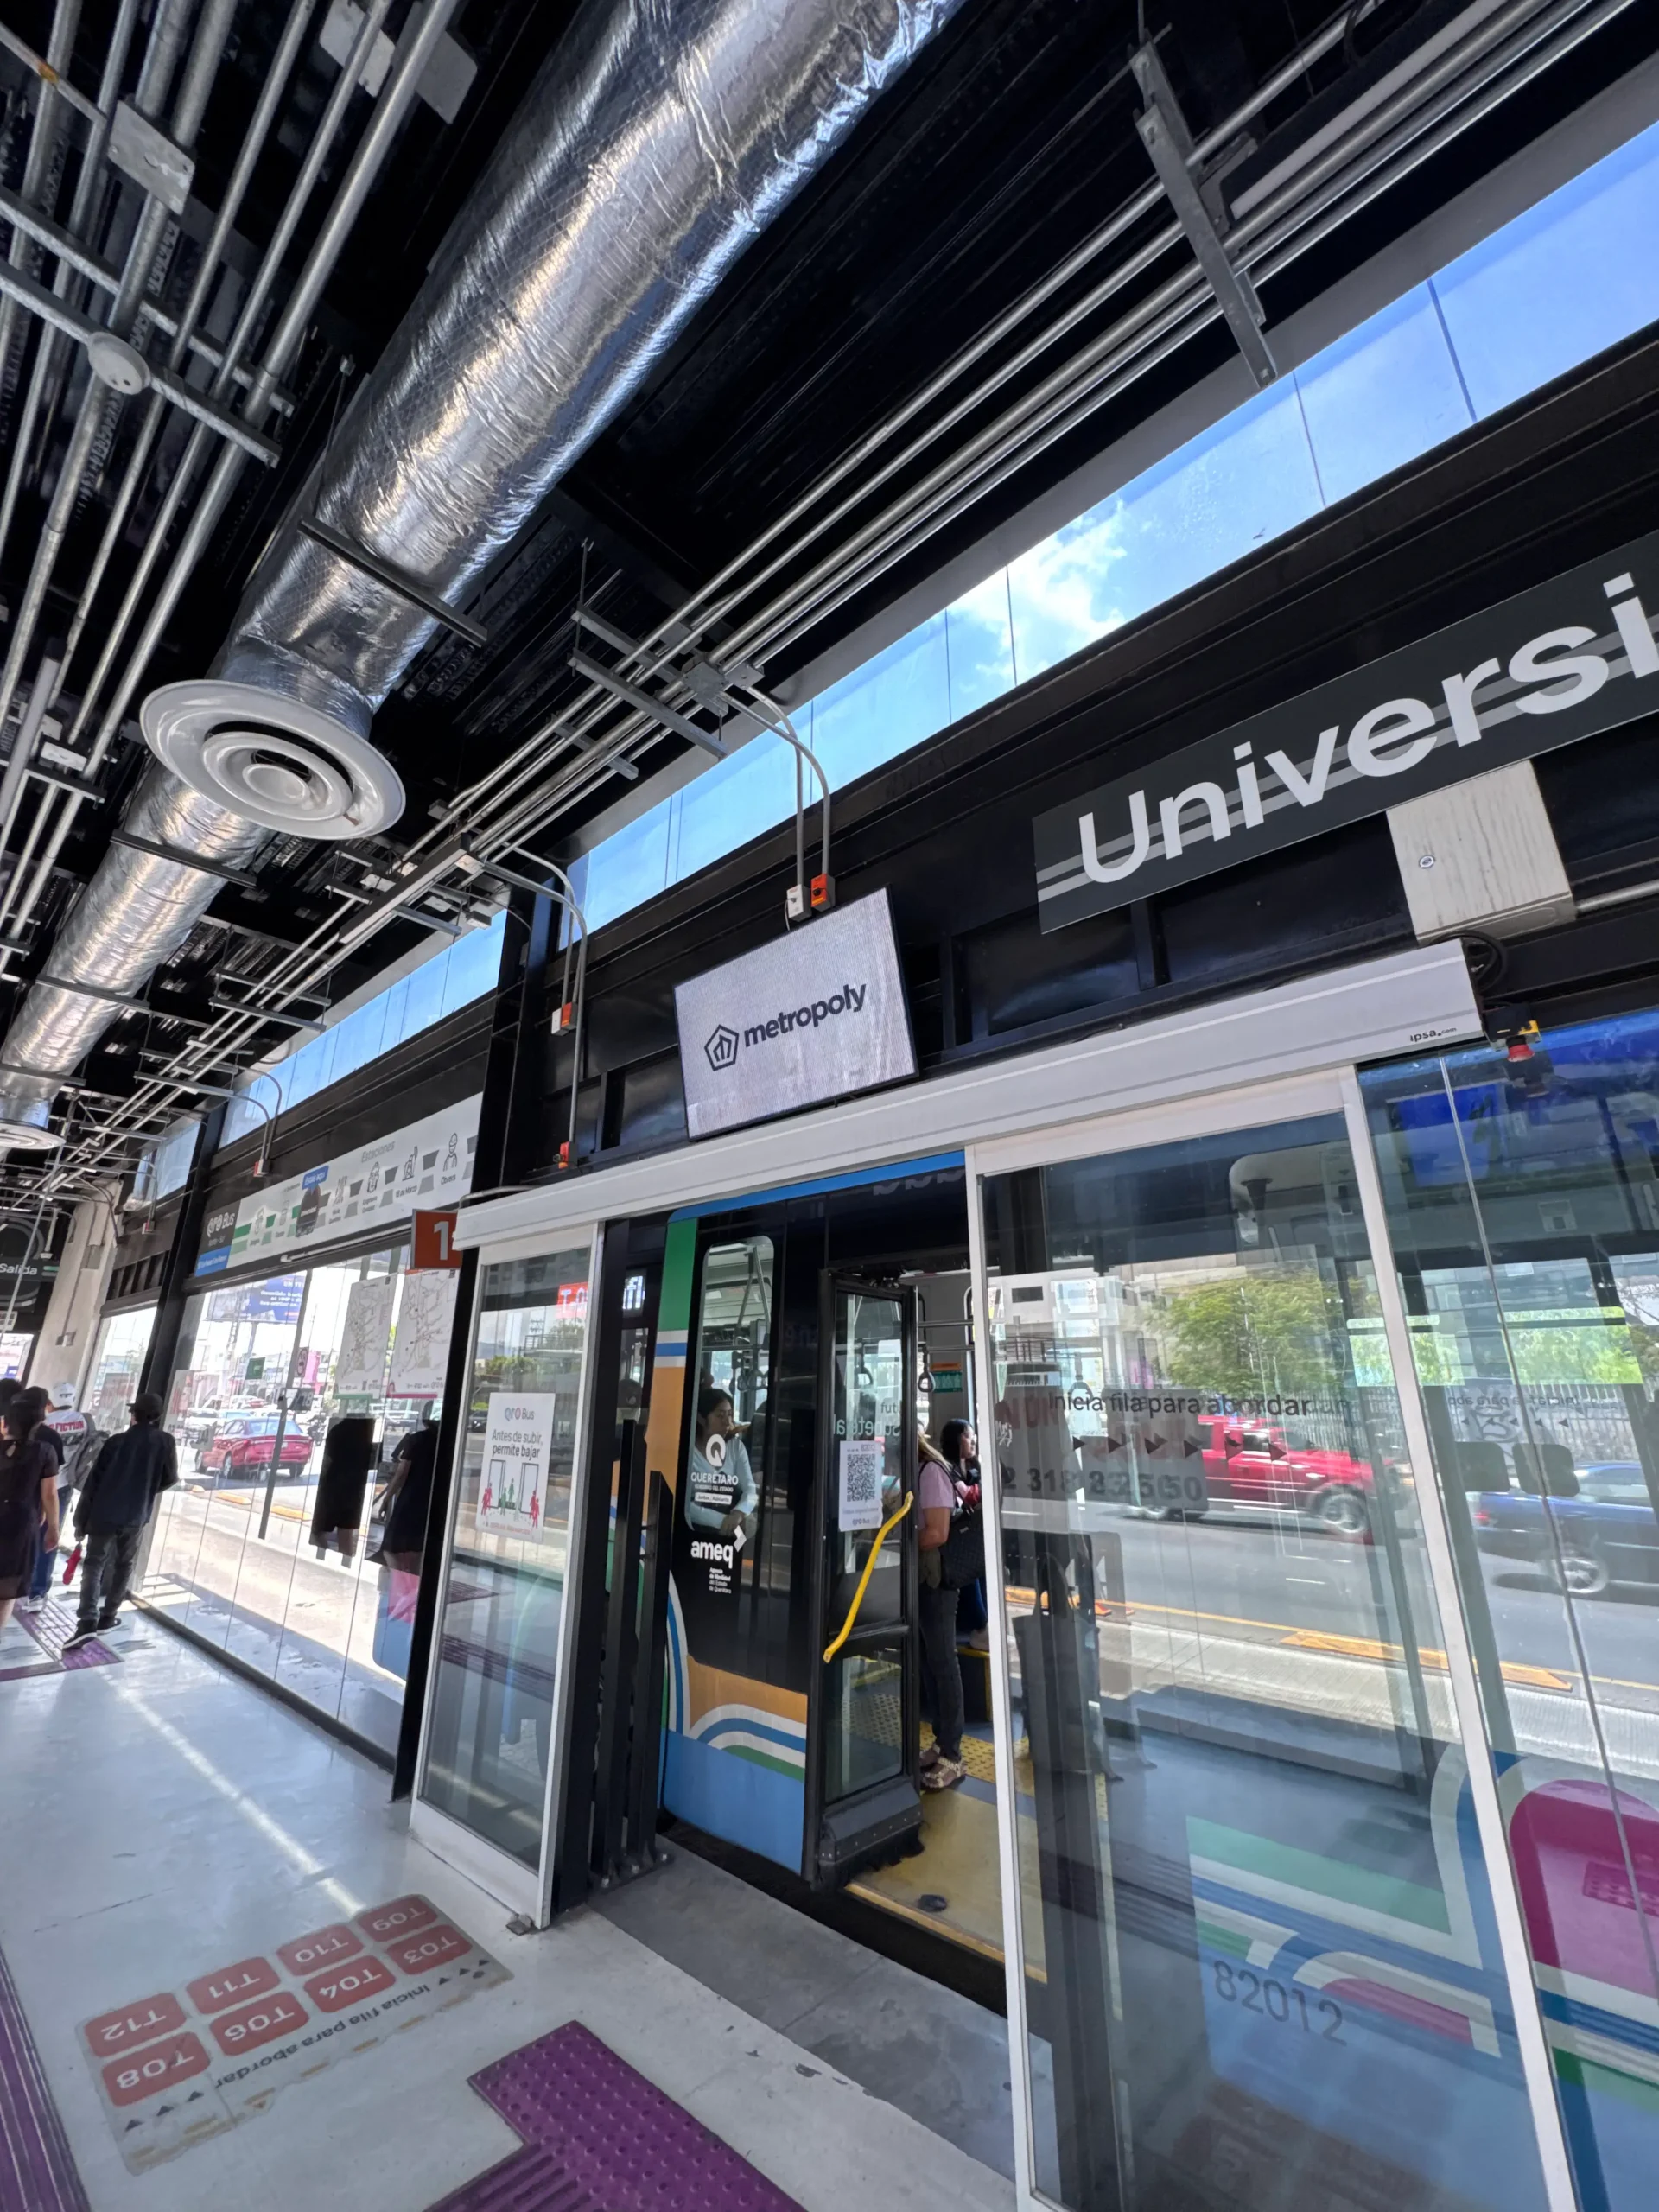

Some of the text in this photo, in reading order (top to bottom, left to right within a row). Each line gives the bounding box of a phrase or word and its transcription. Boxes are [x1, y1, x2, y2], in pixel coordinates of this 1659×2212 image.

[1077, 571, 1659, 885] Universi
[744, 983, 867, 1048] metropoly
[361, 1141, 396, 1164] Estaciones
[433, 1220, 449, 1261] 1
[522, 1408, 535, 1421] Bus
[492, 1428, 543, 1446] Antes de subir,
[492, 1444, 540, 1461] permite bajar
[690, 1470, 739, 1485] QUERÉTARO
[690, 1540, 734, 1569] ameq
[372, 1906, 427, 1932] T09
[294, 1937, 350, 1964] T10
[402, 1935, 458, 1965] T03
[207, 1972, 261, 1999] T11
[318, 1968, 383, 1999] T04
[1213, 1959, 1348, 2047] 82012
[99, 2009, 168, 2042] T12
[215, 1984, 431, 2089] Inicia fila para abordar
[115, 2050, 195, 2089] T08
